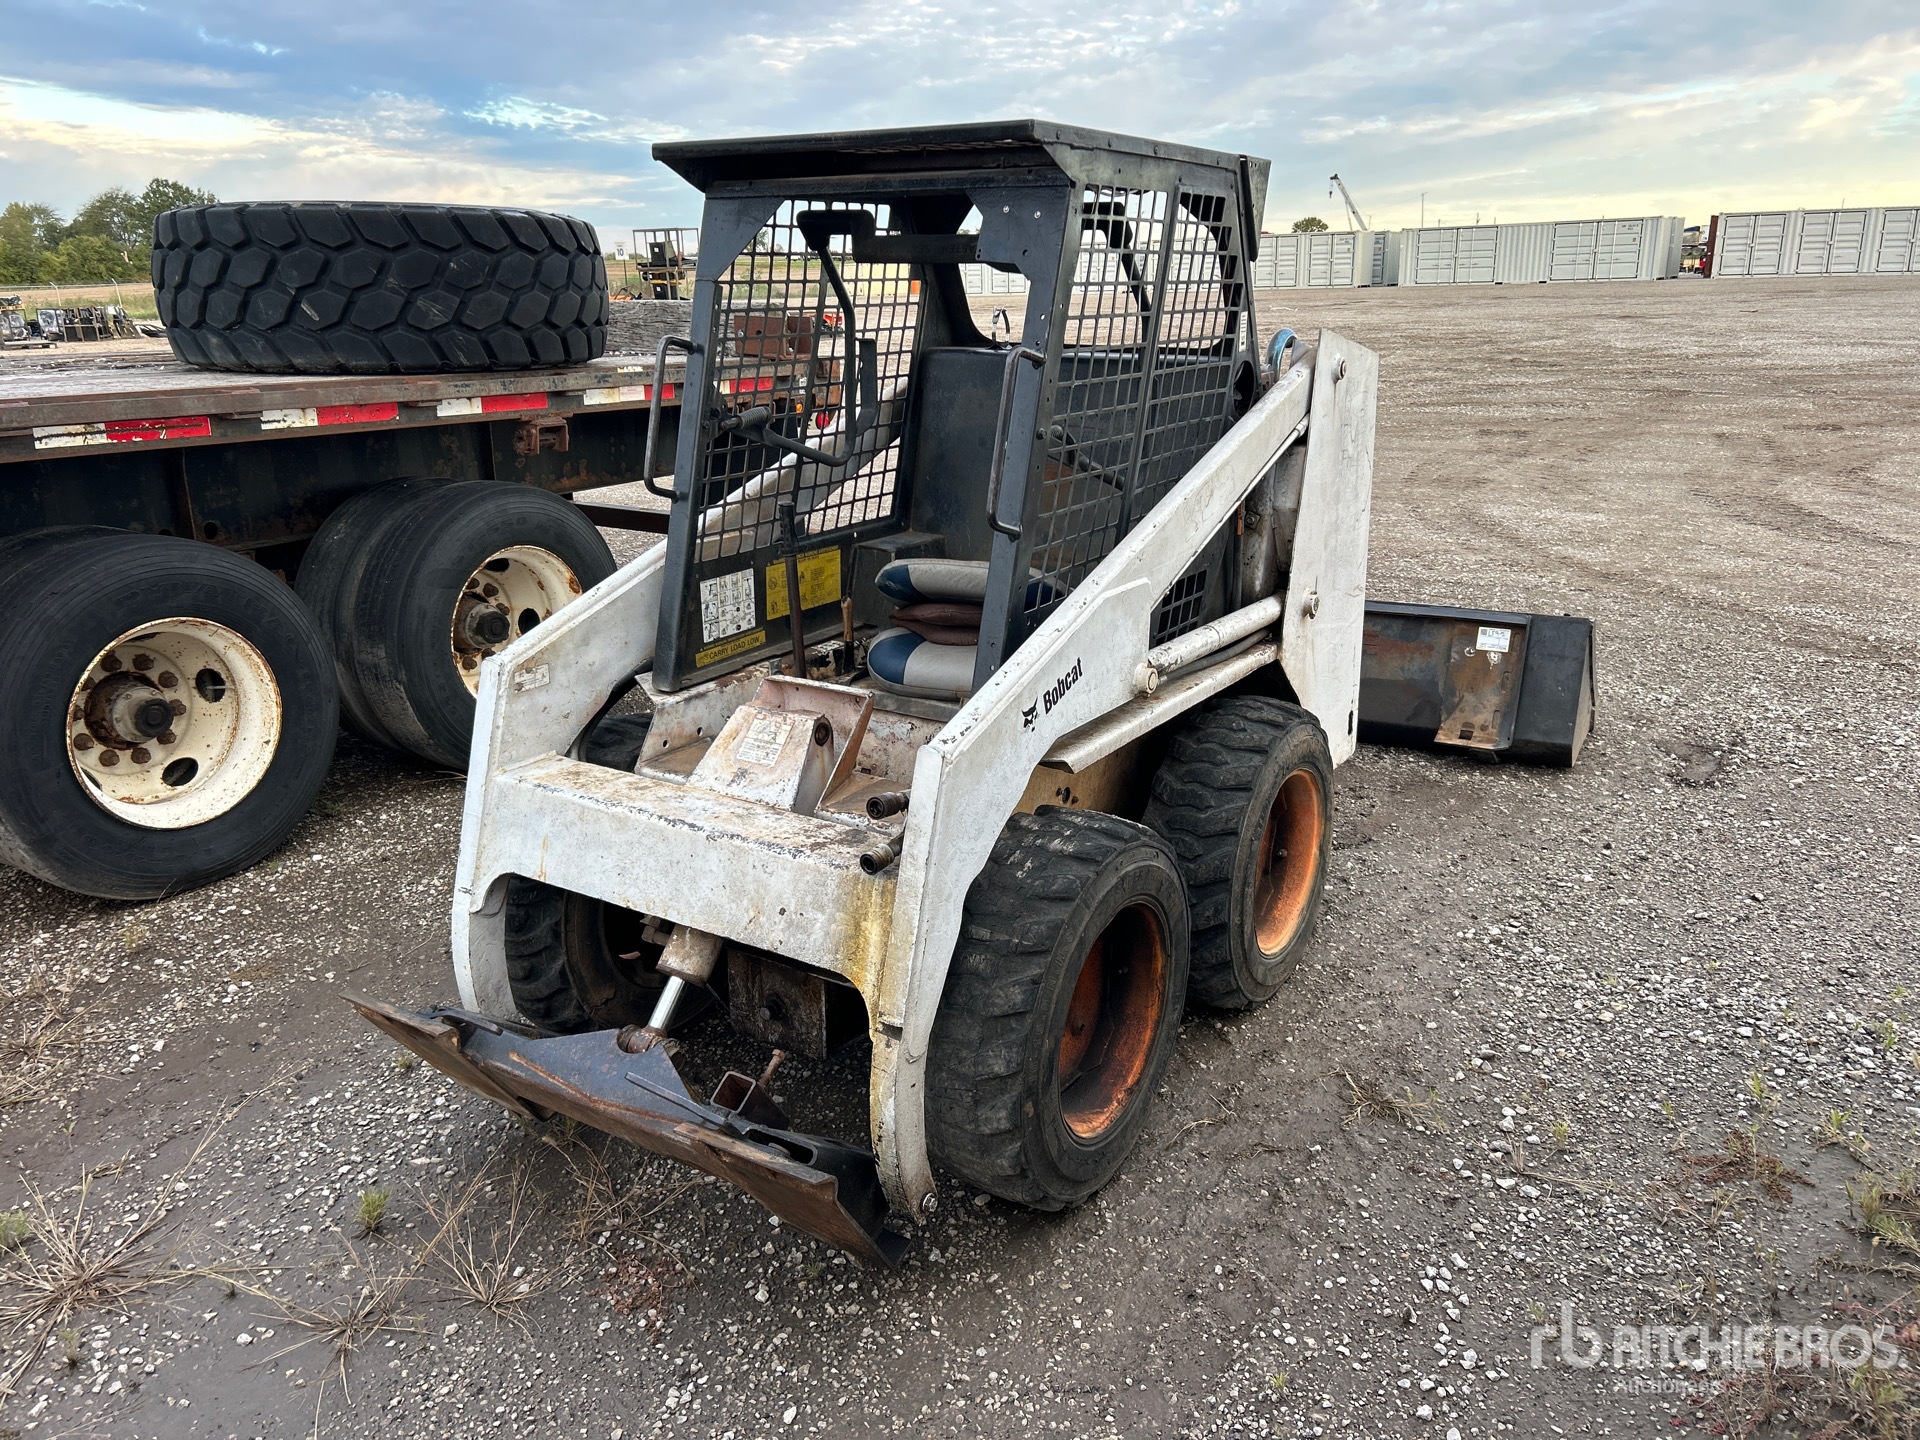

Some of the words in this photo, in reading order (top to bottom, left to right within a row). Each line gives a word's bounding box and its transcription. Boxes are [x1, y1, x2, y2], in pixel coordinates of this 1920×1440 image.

[616, 248, 624, 256] 10
[709, 646, 729, 660] CARRY
[730, 641, 746, 652] LOAD
[747, 636, 761, 646] LOW
[1042, 656, 1083, 715] Bobcat
